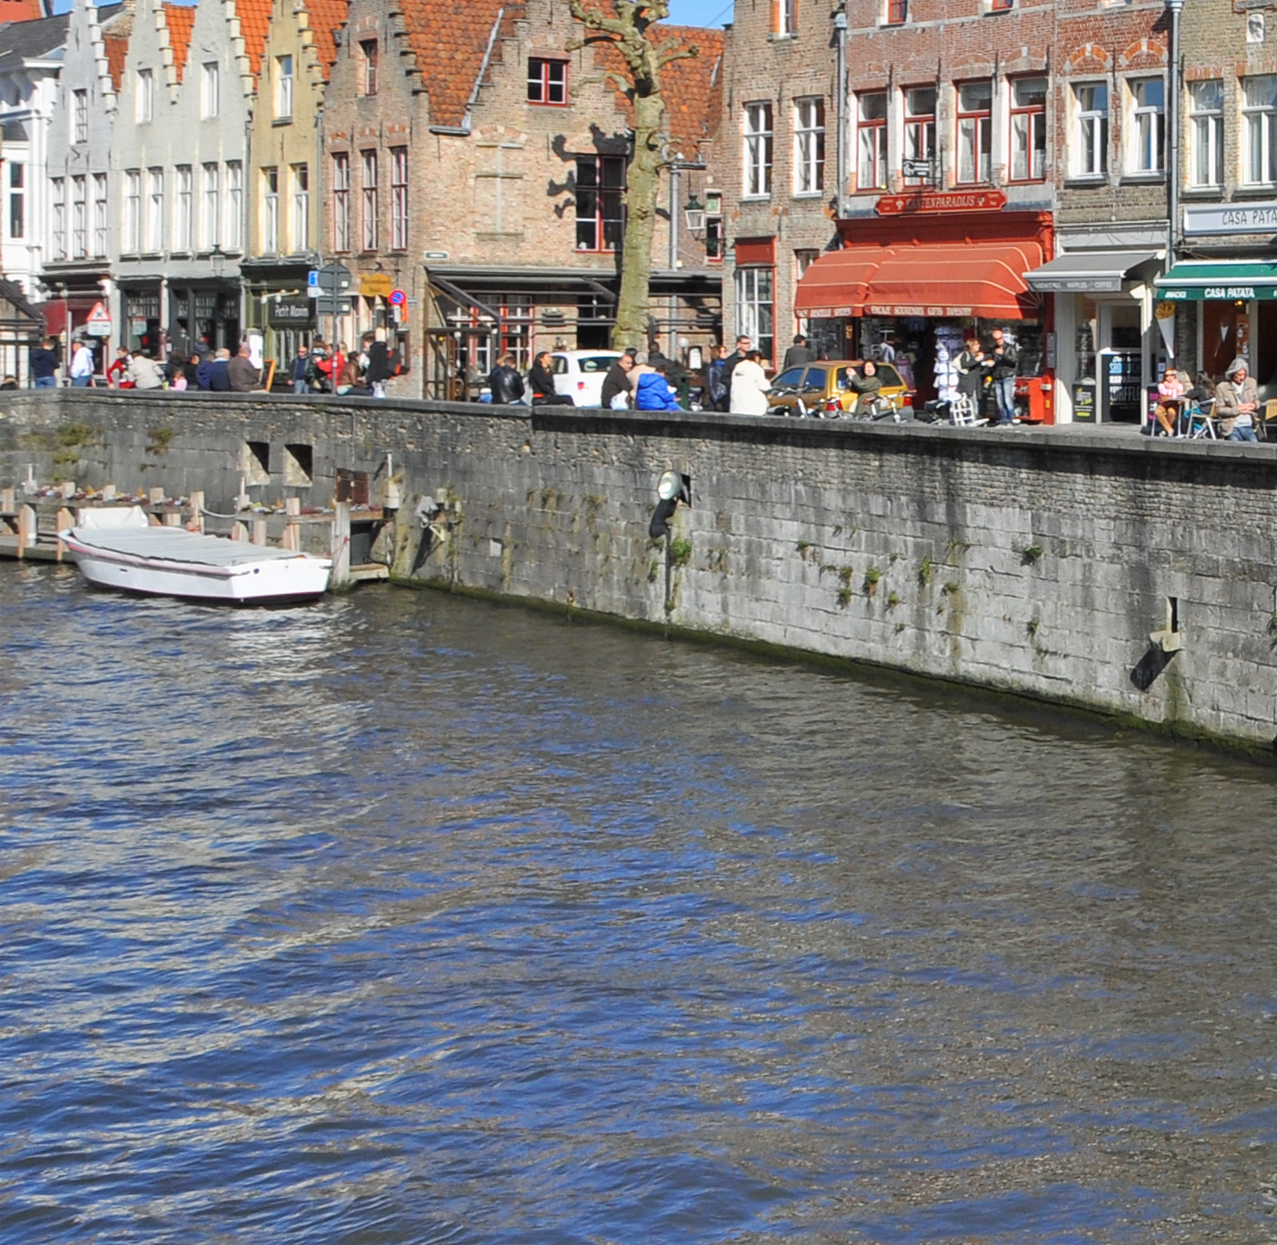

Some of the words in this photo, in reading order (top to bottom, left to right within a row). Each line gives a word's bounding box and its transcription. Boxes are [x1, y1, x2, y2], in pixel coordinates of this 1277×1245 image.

[1222, 211, 1247, 226] CASA
[1204, 288, 1225, 298] CASA
[1227, 288, 1255, 298] PATATA
